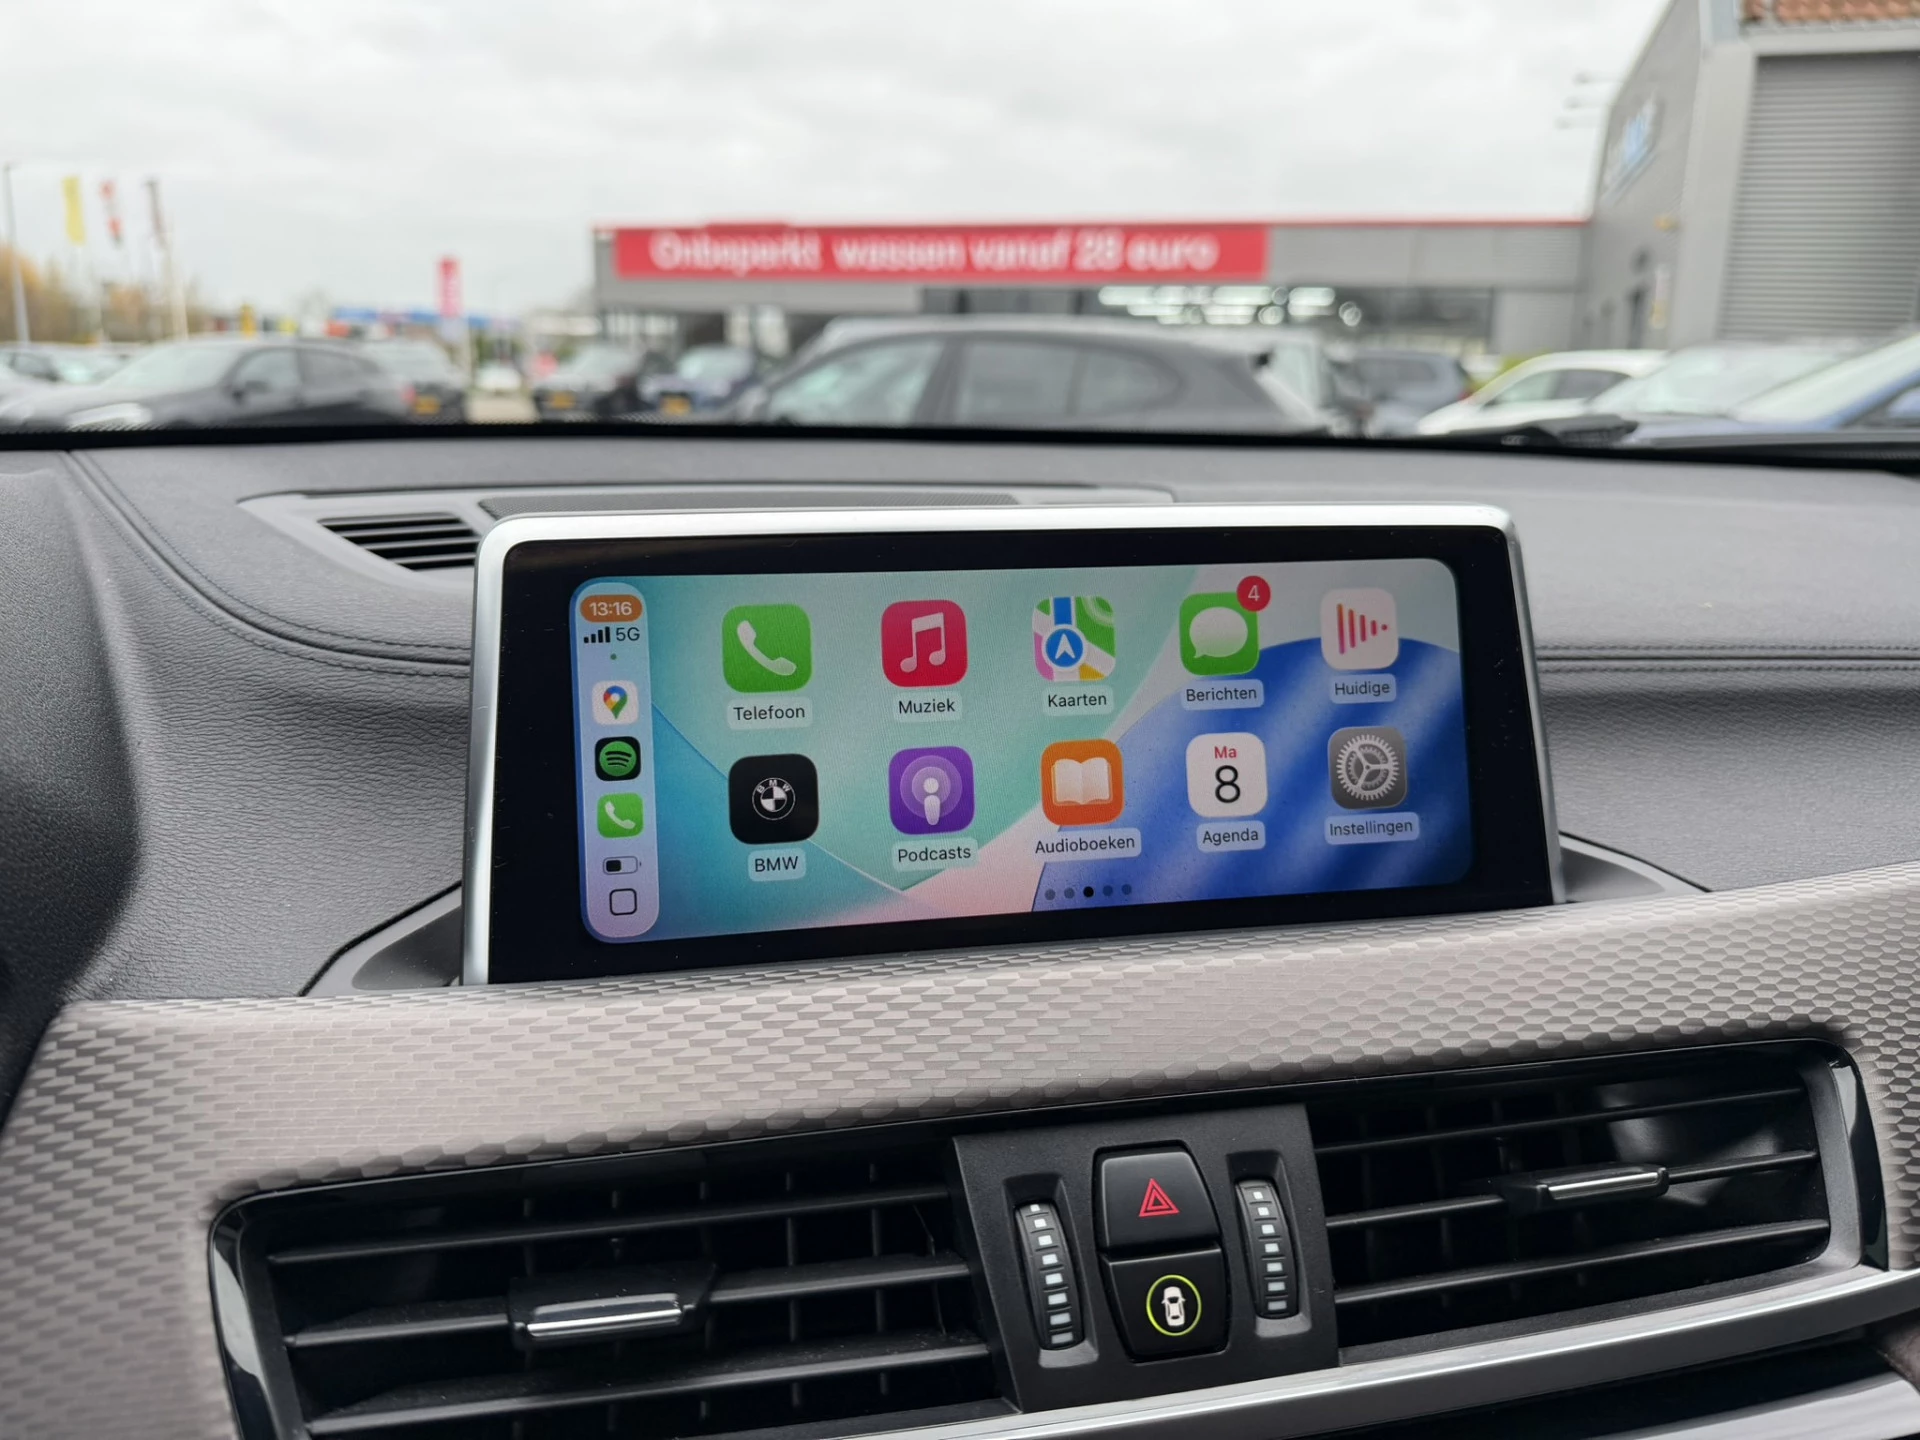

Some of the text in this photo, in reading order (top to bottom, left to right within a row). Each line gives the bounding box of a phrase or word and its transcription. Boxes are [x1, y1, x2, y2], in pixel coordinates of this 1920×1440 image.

[832, 236, 967, 274] wassen
[1125, 236, 1219, 272] euro
[1247, 584, 1260, 601] 4
[588, 601, 633, 617] 13:16
[615, 627, 641, 643] 5G
[1185, 685, 1258, 703] Berichten
[1334, 680, 1391, 699] Huidige
[898, 698, 956, 715] Muziek
[1047, 691, 1107, 708] Kaarten
[733, 704, 806, 722] Telefoon
[1213, 745, 1238, 760] Ma
[1213, 764, 1242, 804] 8
[1202, 827, 1260, 845] Agenda
[1329, 818, 1414, 838] Instellingen
[897, 845, 972, 863] Podcasts
[1035, 835, 1136, 855] Audioboeken
[754, 855, 799, 874] BMW
